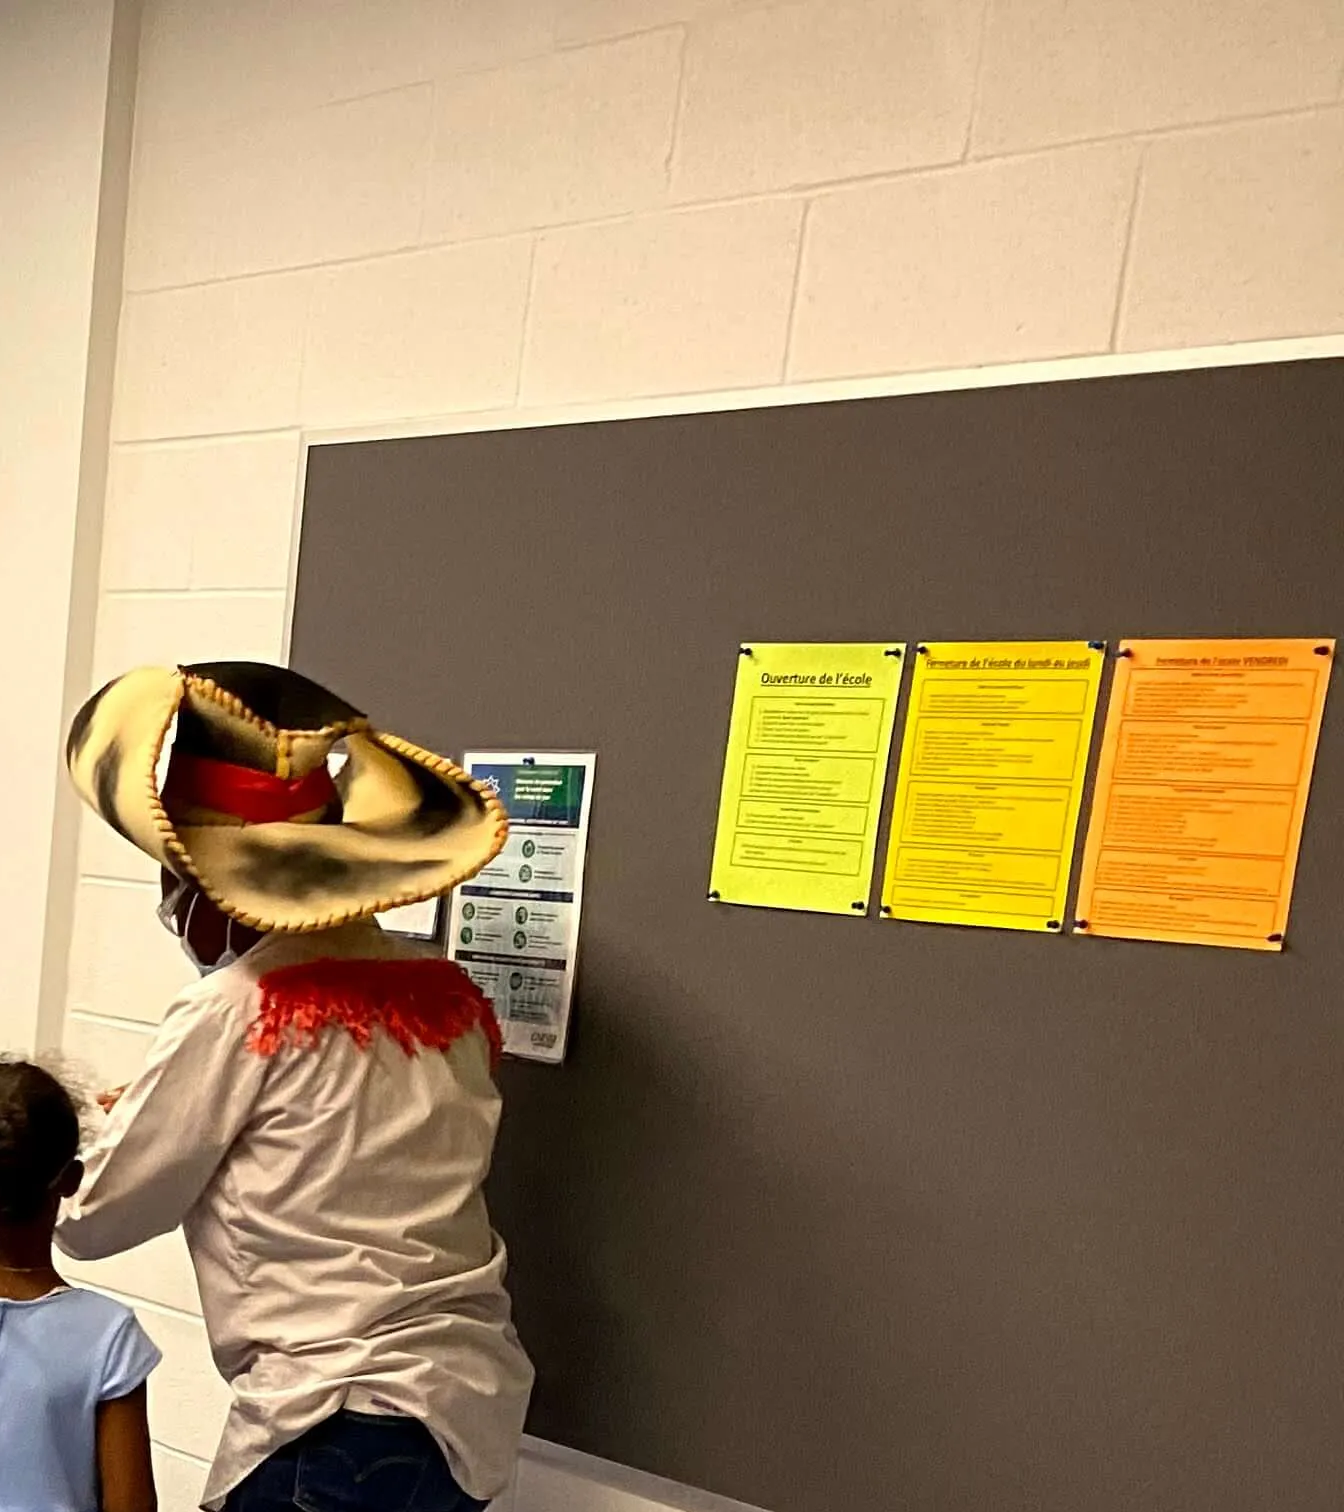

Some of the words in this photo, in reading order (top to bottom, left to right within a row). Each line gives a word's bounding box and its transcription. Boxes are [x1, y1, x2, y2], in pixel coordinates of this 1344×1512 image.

[926, 658, 967, 669] Fermeture
[970, 658, 980, 668] de
[1014, 658, 1026, 668] du
[1028, 658, 1051, 669] lundi
[1053, 660, 1065, 668] au
[1066, 658, 1091, 670] jeudi
[761, 673, 817, 685] Ouverture
[818, 673, 833, 685] de
